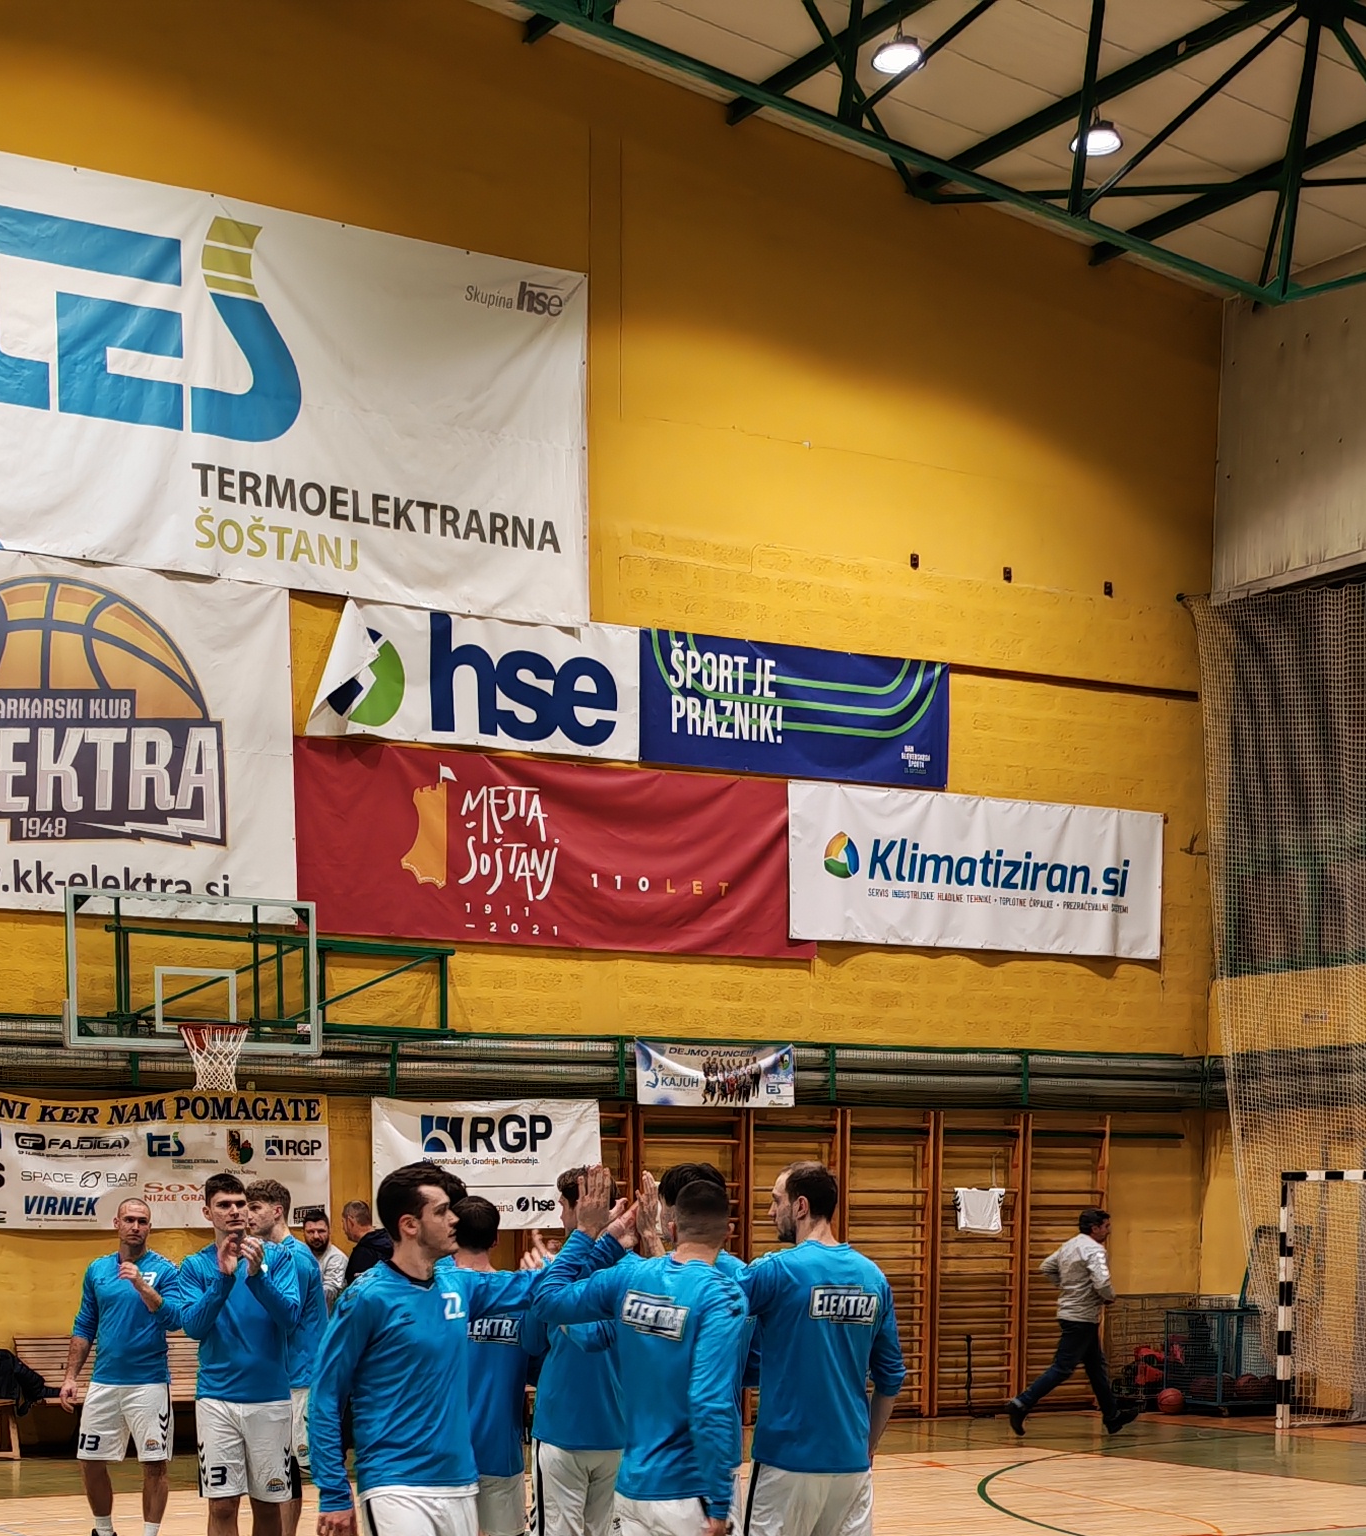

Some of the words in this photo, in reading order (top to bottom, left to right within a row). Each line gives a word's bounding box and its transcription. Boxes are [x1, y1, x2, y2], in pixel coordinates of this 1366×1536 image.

[465, 285, 514, 309] Skupina
[517, 281, 563, 317] hse
[191, 462, 561, 553] TERMOELEKTRARNA
[193, 505, 359, 572] ŠOŠTANJ
[429, 611, 618, 746] hse
[670, 640, 748, 694] ŠPORT
[753, 658, 776, 698] JE
[89, 698, 131, 719] KLUB
[671, 695, 783, 744] PRAZNIK!
[461, 785, 548, 843] MESTA
[19, 817, 67, 838] 1948
[458, 821, 560, 901] ŠOŠTANJ
[868, 838, 1130, 897] Klimatiziran.si
[591, 873, 650, 892] 110
[666, 879, 729, 896] LET
[868, 888, 888, 898] SERVIS
[465, 903, 530, 916] 1911
[669, 1047, 709, 1057] DEJMO
[661, 1077, 699, 1087] KAJUH
[36, 1105, 100, 1124] KER
[107, 1099, 167, 1125] NAM
[174, 1096, 321, 1121] POMAGATE
[48, 1138, 124, 1150] FAJDIGA
[469, 1114, 553, 1153] RGP
[286, 1140, 322, 1155] RGP
[21, 1171, 74, 1183] SPACE
[106, 1173, 138, 1183] BAR
[143, 1183, 205, 1193] SOV
[143, 1193, 176, 1201] NIZKE
[181, 1193, 206, 1201] GRA
[24, 1195, 100, 1216] VIRNEK
[532, 1197, 555, 1211] hse
[812, 1289, 877, 1317] ELEKTRA
[467, 1318, 519, 1337] LEKTRA
[78, 1433, 101, 1451] 13
[211, 1466, 227, 1486] 3
